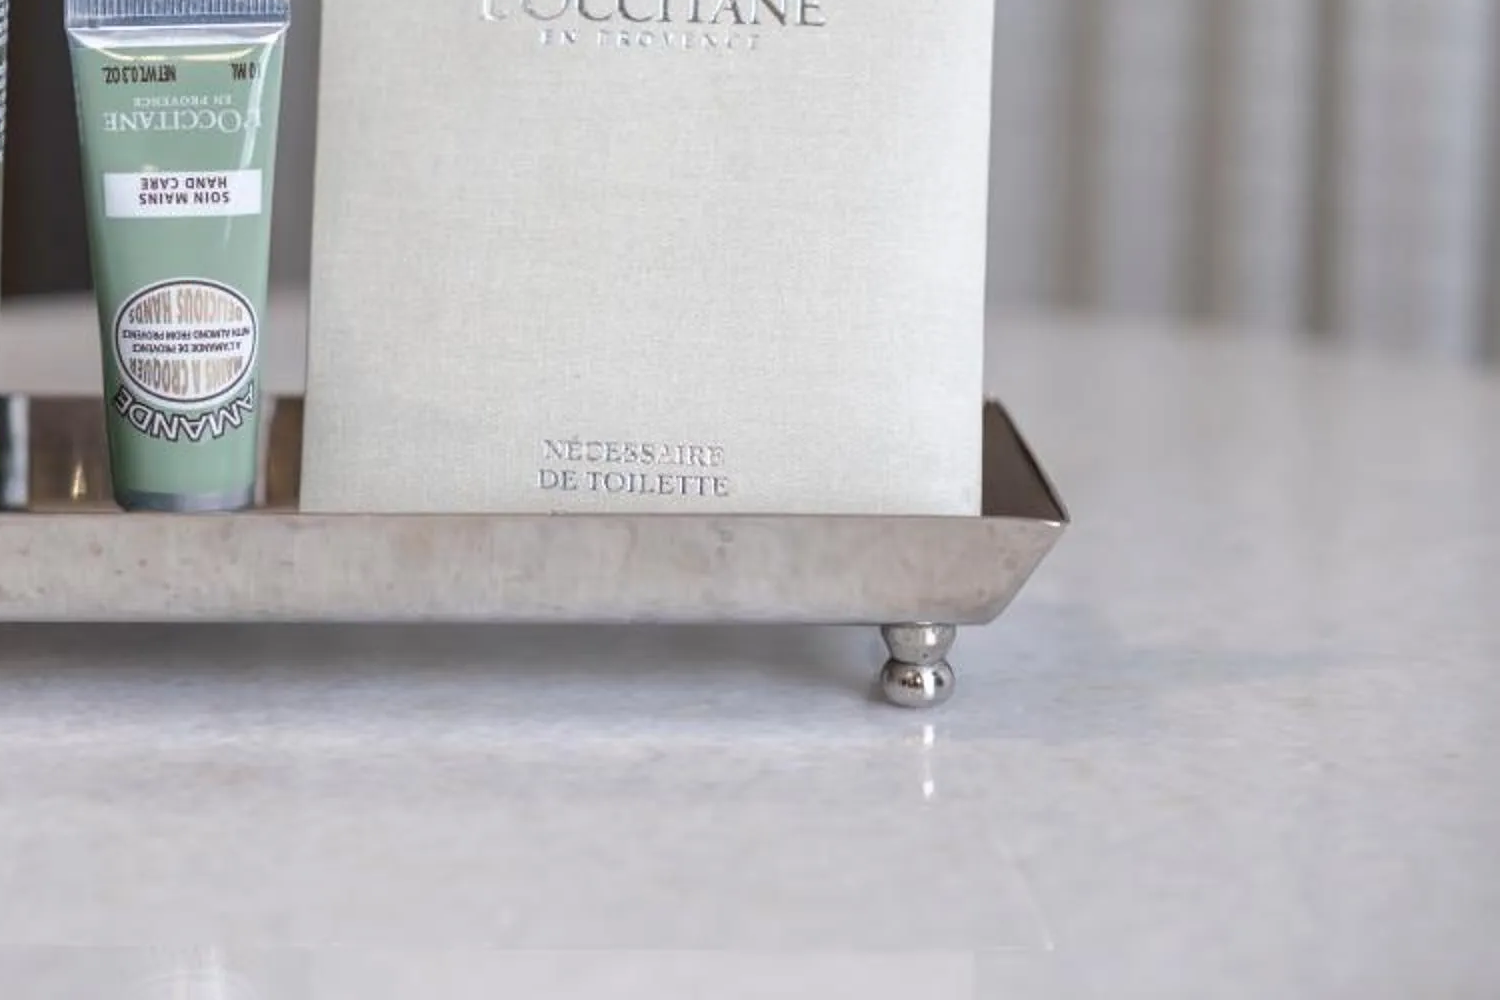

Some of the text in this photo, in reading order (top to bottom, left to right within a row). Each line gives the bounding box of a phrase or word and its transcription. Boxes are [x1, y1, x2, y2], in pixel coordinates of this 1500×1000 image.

[538, 28, 577, 47] EN
[140, 176, 228, 190] HAND CARE
[139, 191, 230, 206] SOIN MAINS
[113, 380, 257, 443] AMANDE
[543, 433, 725, 468] NÉCESSAIRE
[536, 467, 730, 498] DE TOILETTE
